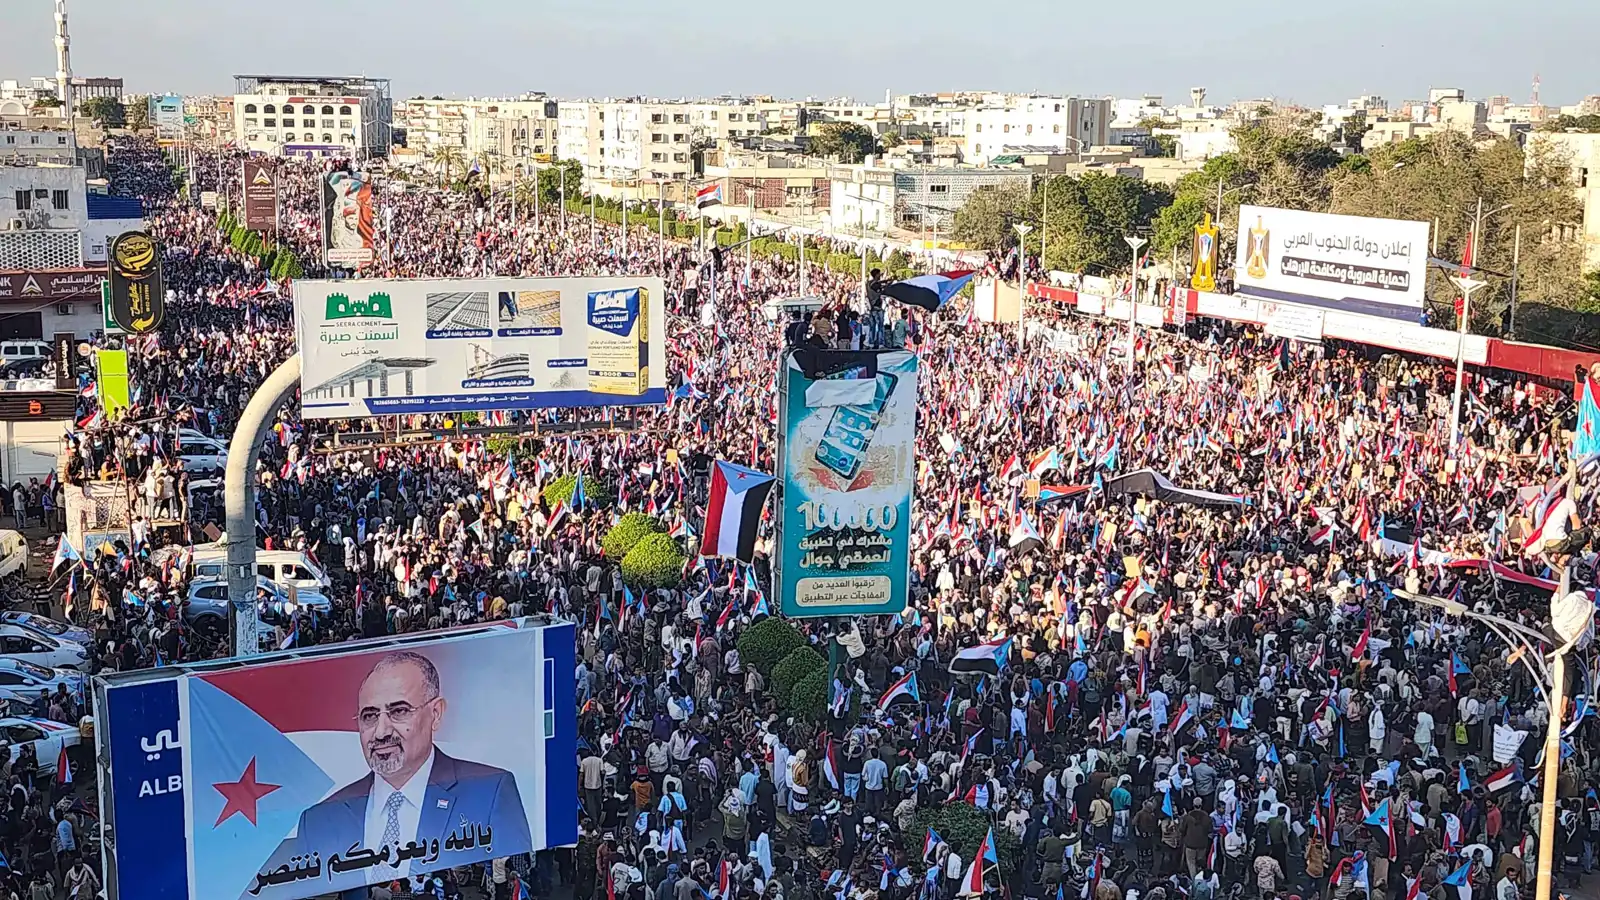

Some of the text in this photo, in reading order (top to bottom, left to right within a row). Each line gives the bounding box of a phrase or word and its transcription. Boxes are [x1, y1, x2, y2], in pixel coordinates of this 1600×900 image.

[1284, 232, 1412, 264] إعلان دولة الجنوب العربي
[50, 274, 92, 288] الإسلامي
[1282, 258, 1409, 288] لحماية العروبة ومكافحة الإرهاب
[320, 326, 398, 345] أسمنت صيرة
[798, 534, 892, 550] مشترك في تطبيق
[799, 550, 891, 569] العمقي جوال
[826, 581, 849, 589] العديد
[852, 579, 875, 589] ترقبوا
[802, 593, 833, 603] التطبيق
[850, 590, 884, 600] المفاجآت
[139, 774, 182, 798] ALB
[247, 814, 492, 897] بالله وبعزمكم ننتصر
